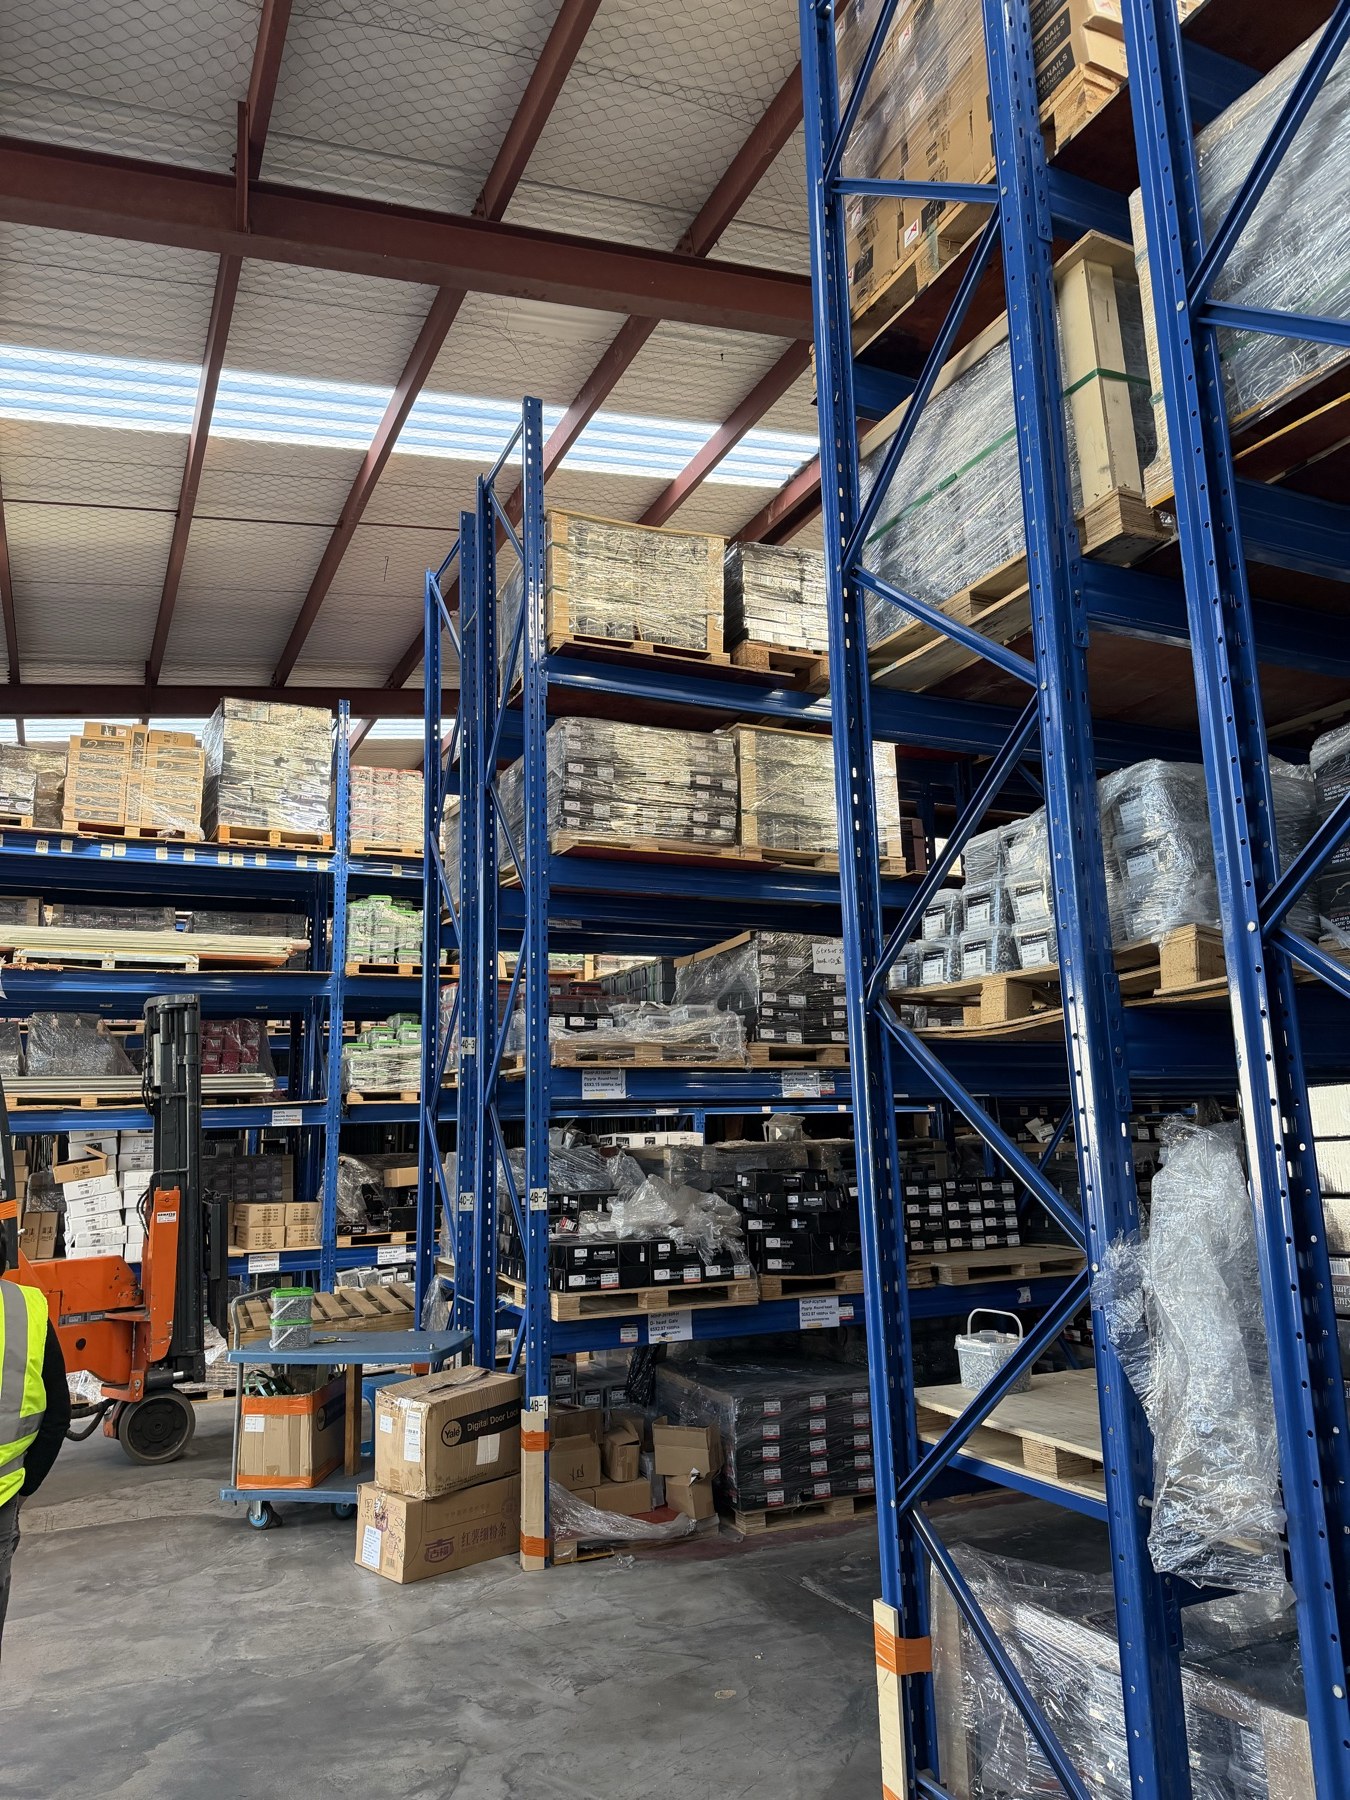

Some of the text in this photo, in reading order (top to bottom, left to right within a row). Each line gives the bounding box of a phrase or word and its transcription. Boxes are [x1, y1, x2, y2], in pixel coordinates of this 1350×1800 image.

[1044, 18, 1065, 41] NAILS
[1046, 53, 1068, 79] NAILS
[530, 1191, 547, 1203] 4B-2
[530, 1399, 547, 1411] 4B-1
[445, 1428, 459, 1439] Yale
[467, 1418, 489, 1431] Digital
[490, 1414, 505, 1425] Door
[462, 1522, 507, 1547] 红薯细粉条
